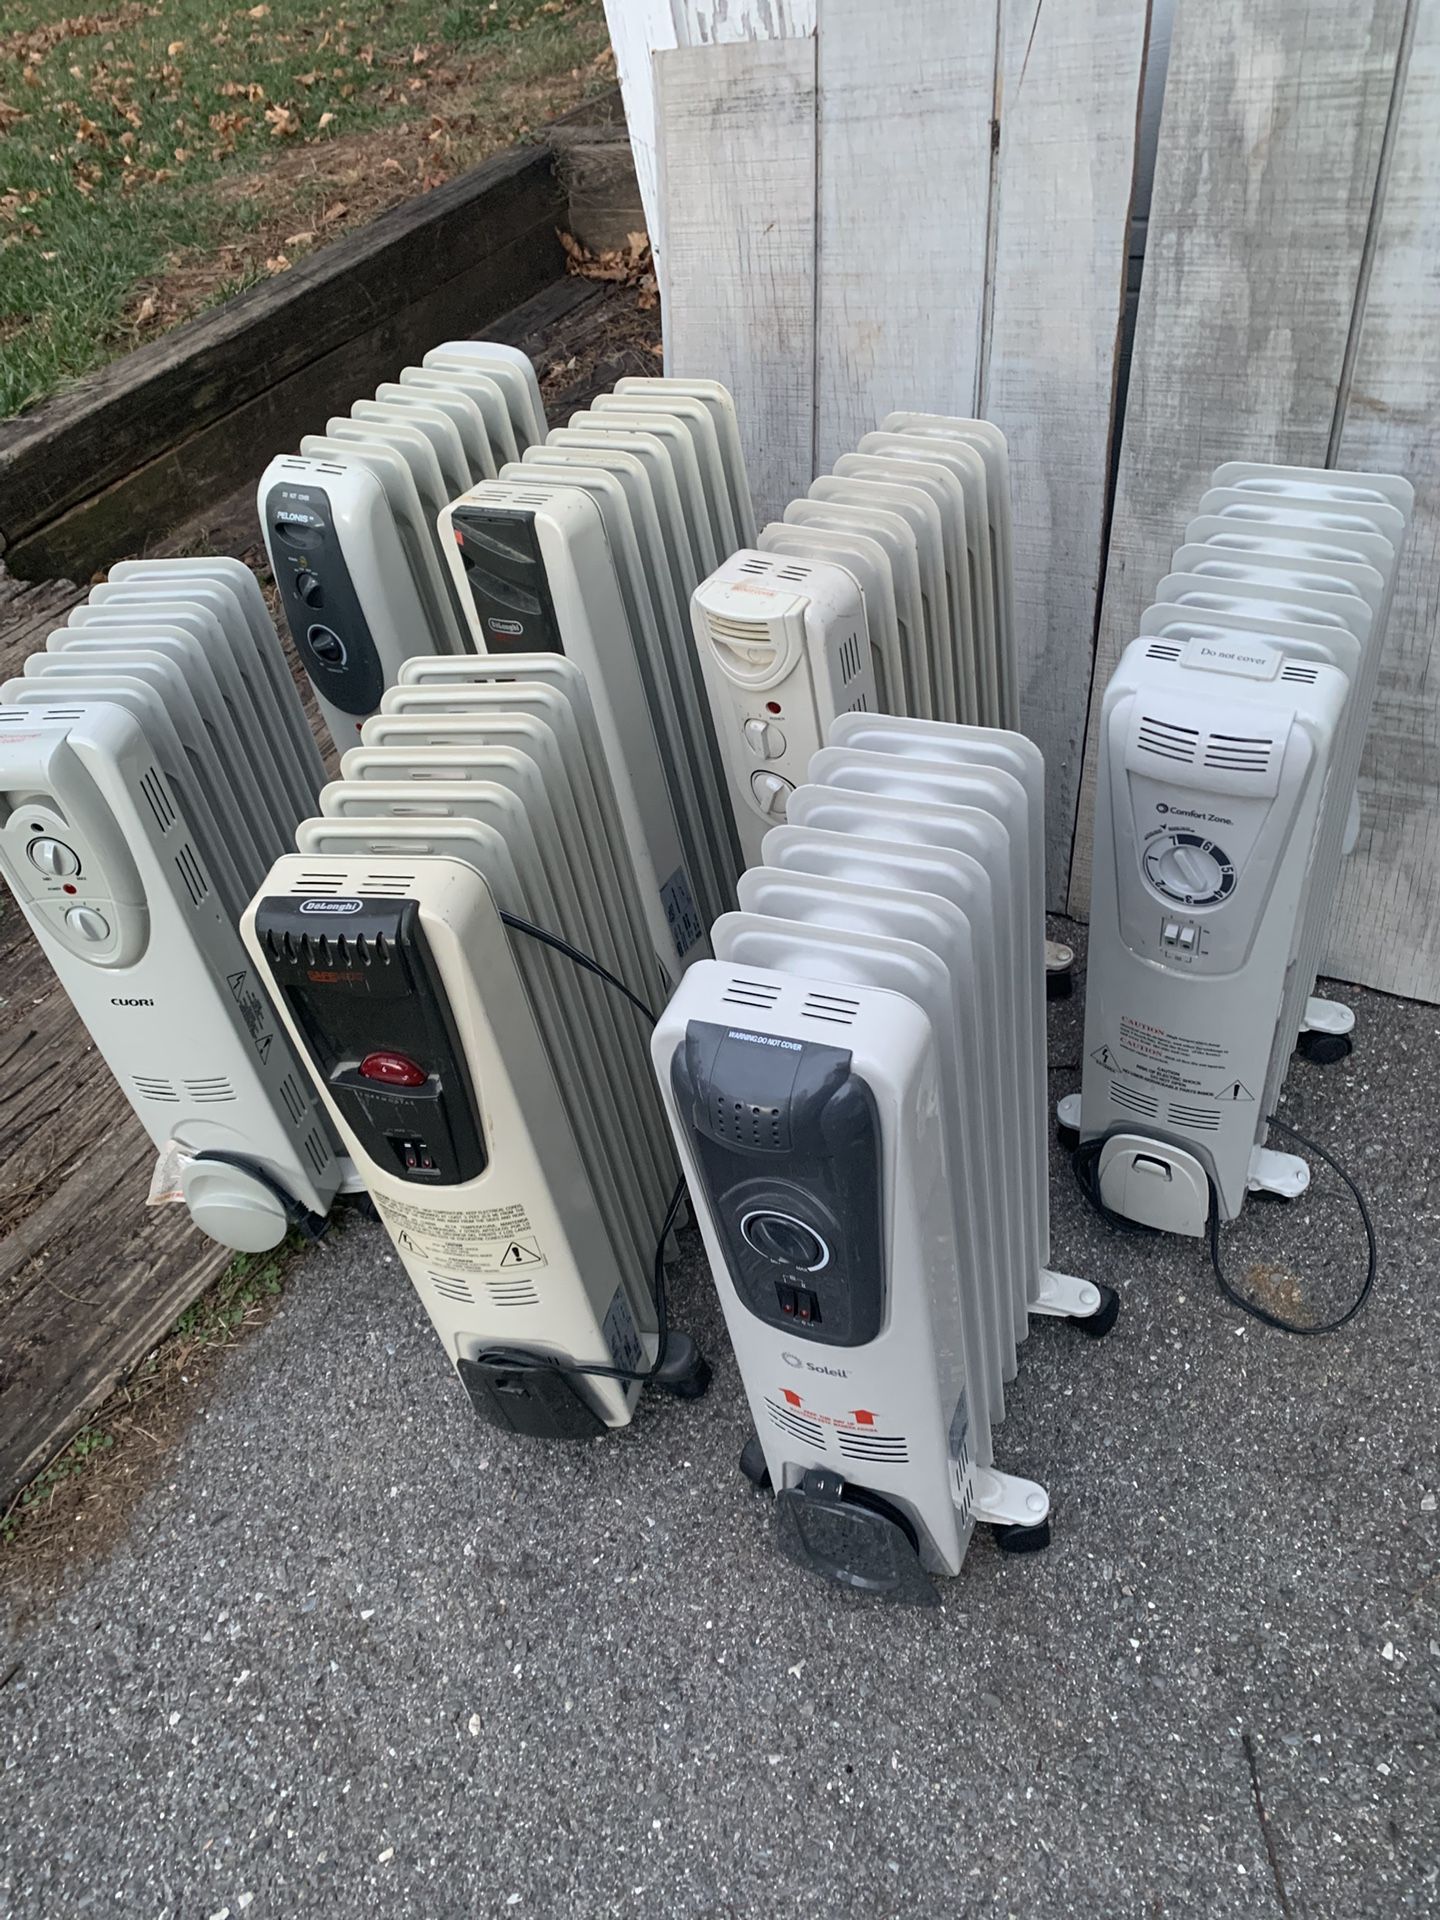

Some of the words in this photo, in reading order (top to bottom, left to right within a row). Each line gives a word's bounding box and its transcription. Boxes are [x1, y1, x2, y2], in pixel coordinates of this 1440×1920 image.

[276, 511, 309, 523] PELONIS
[1200, 647, 1217, 657] Do
[1218, 652, 1236, 660] not
[1236, 655, 1267, 665] cover
[1170, 807, 1206, 820] Comfort
[1168, 835, 1177, 846] 7
[1202, 840, 1213, 852] 6
[1221, 866, 1234, 874] 5
[1155, 879, 1166, 888] 2
[1185, 894, 1193, 904] 3
[1213, 889, 1224, 899] 4
[306, 902, 357, 912] DeLonghi
[1121, 1015, 1164, 1035] CAUTION
[767, 1038, 781, 1047] NOT
[780, 1040, 803, 1051] COVER
[1120, 1036, 1162, 1057] CAUTION
[1157, 1067, 1180, 1076] CAUTION
[805, 1361, 848, 1379] Soleil
